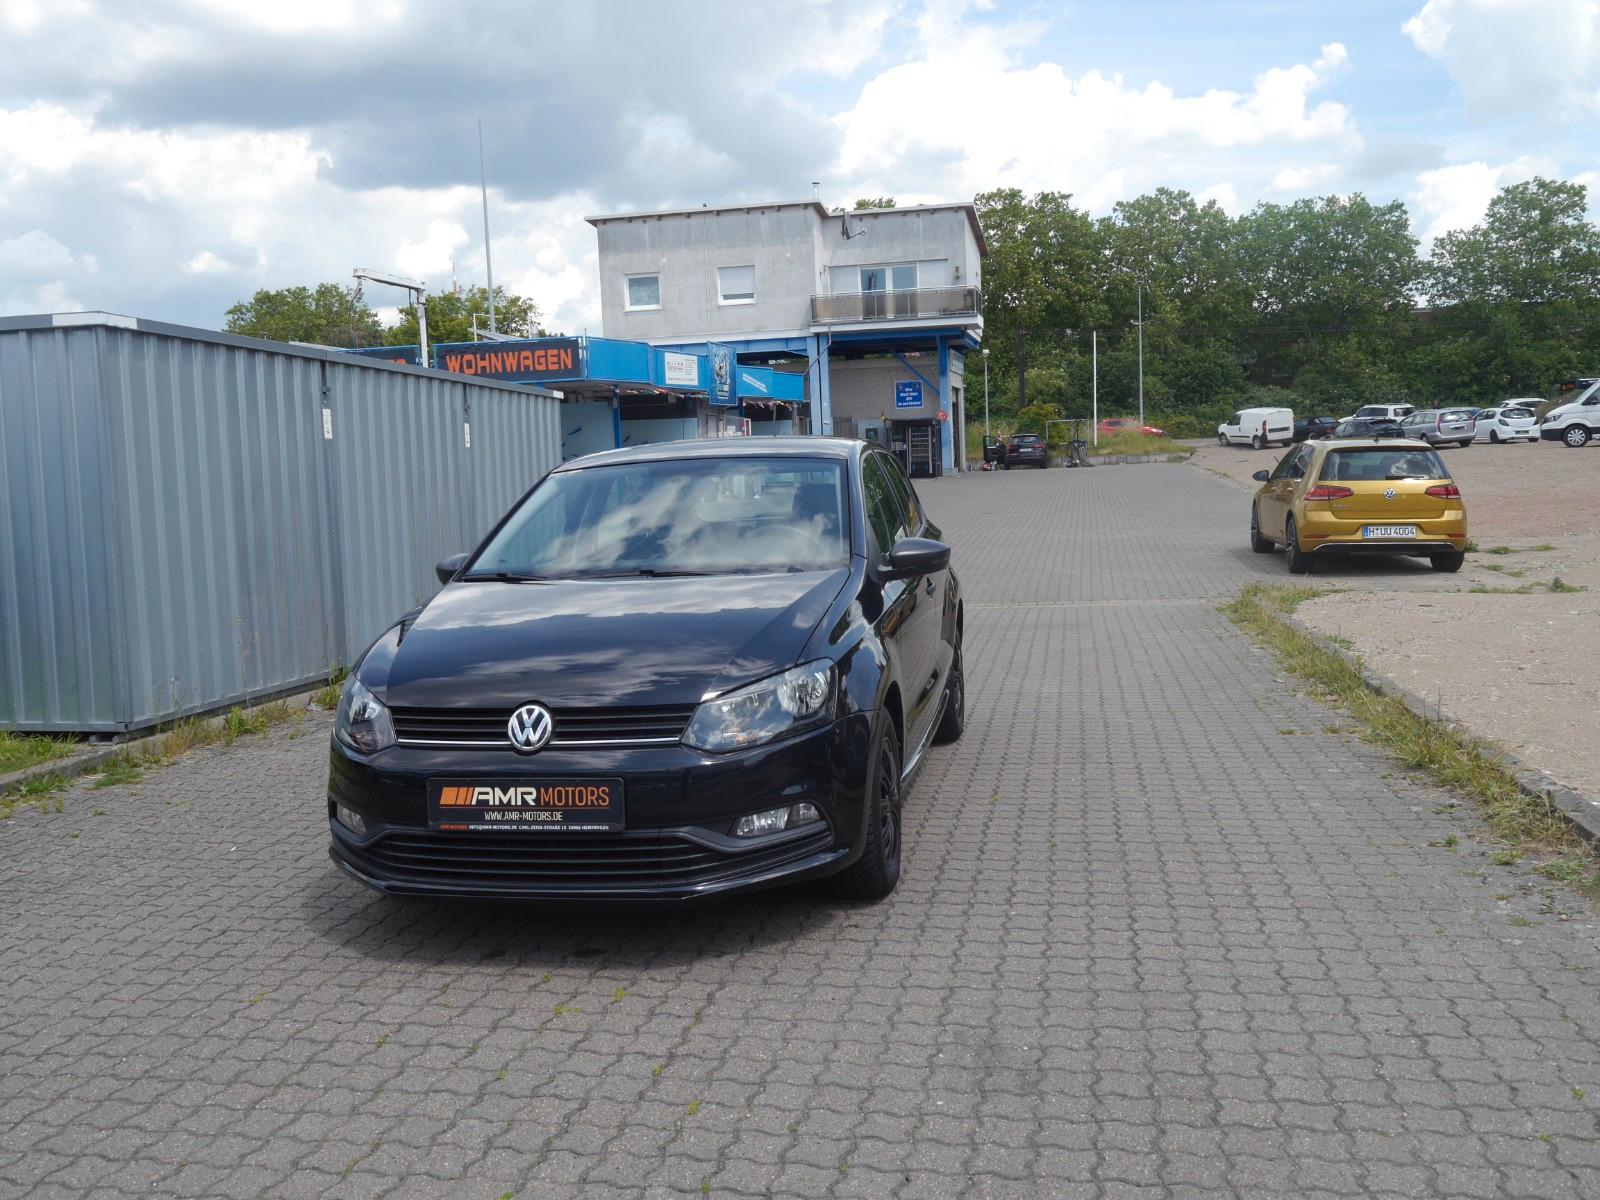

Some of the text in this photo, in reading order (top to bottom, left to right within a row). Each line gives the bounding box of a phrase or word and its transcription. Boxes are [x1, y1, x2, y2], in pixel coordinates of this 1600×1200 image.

[446, 348, 572, 375] WOHNWAGEN
[507, 704, 553, 751] VW
[471, 786, 609, 806] AMR MOTORS
[484, 811, 563, 821] WWW.AMR-MOTORS.DE
